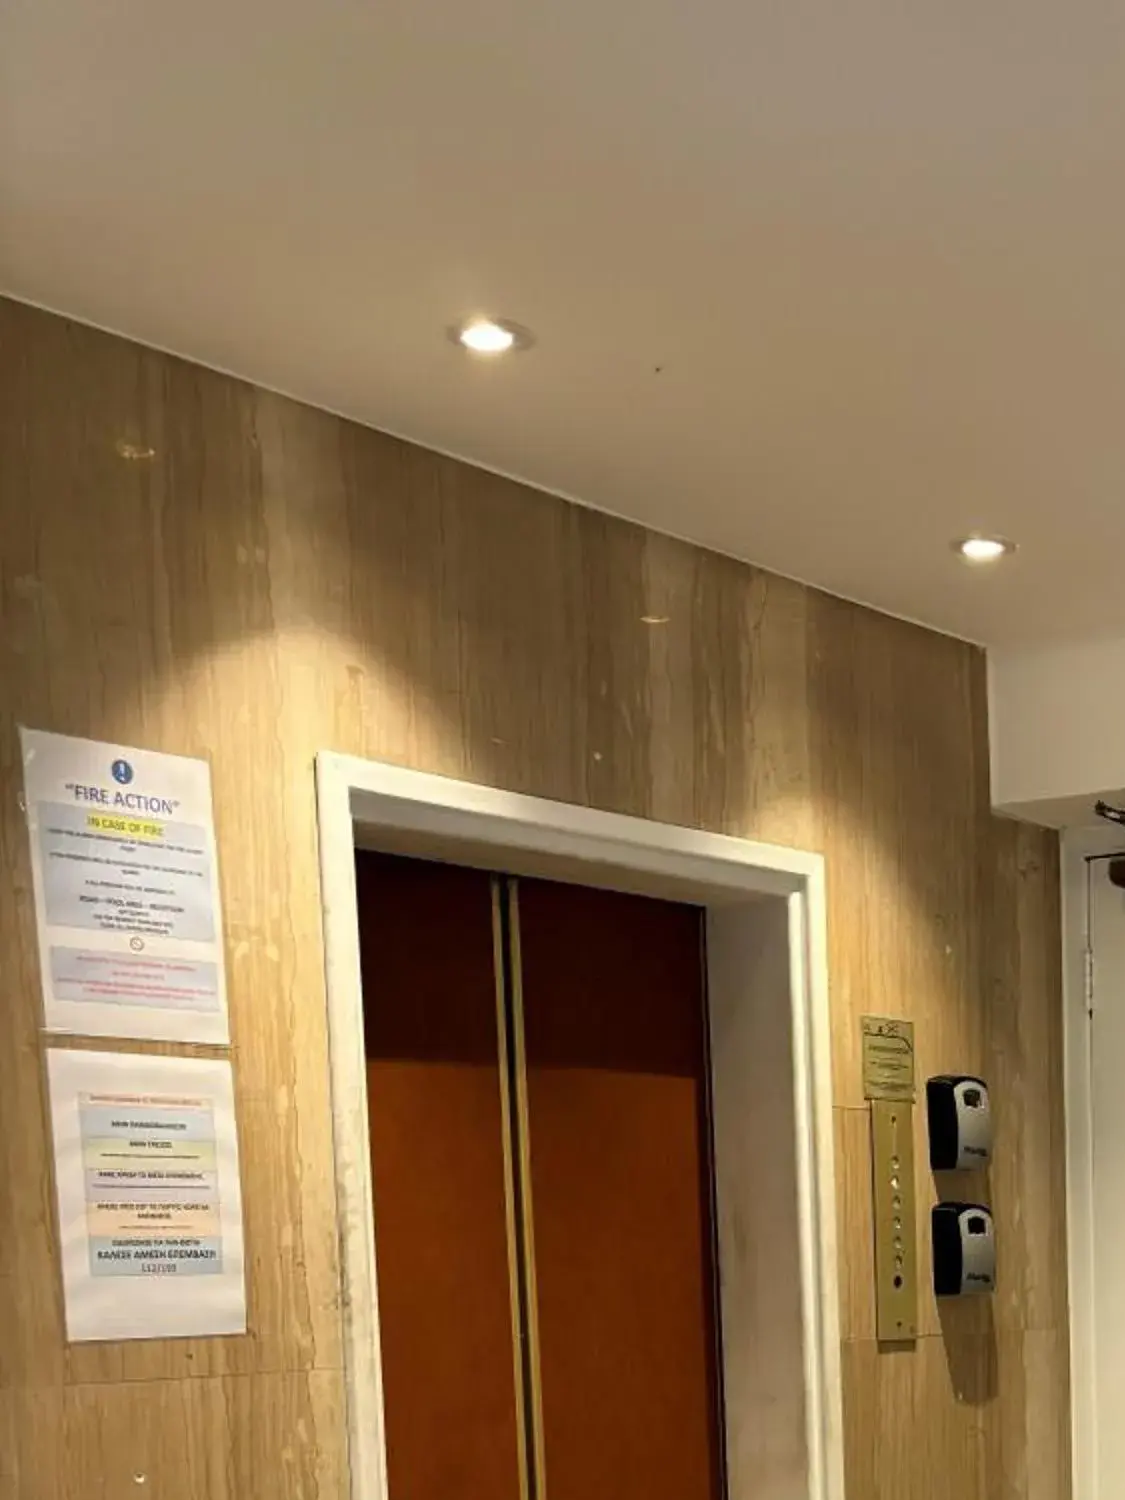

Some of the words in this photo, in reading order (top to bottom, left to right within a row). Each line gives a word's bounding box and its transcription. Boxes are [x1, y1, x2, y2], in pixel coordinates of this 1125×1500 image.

[102, 817, 126, 832] CASE
[128, 822, 141, 834] OF
[143, 823, 165, 838] FIRE
